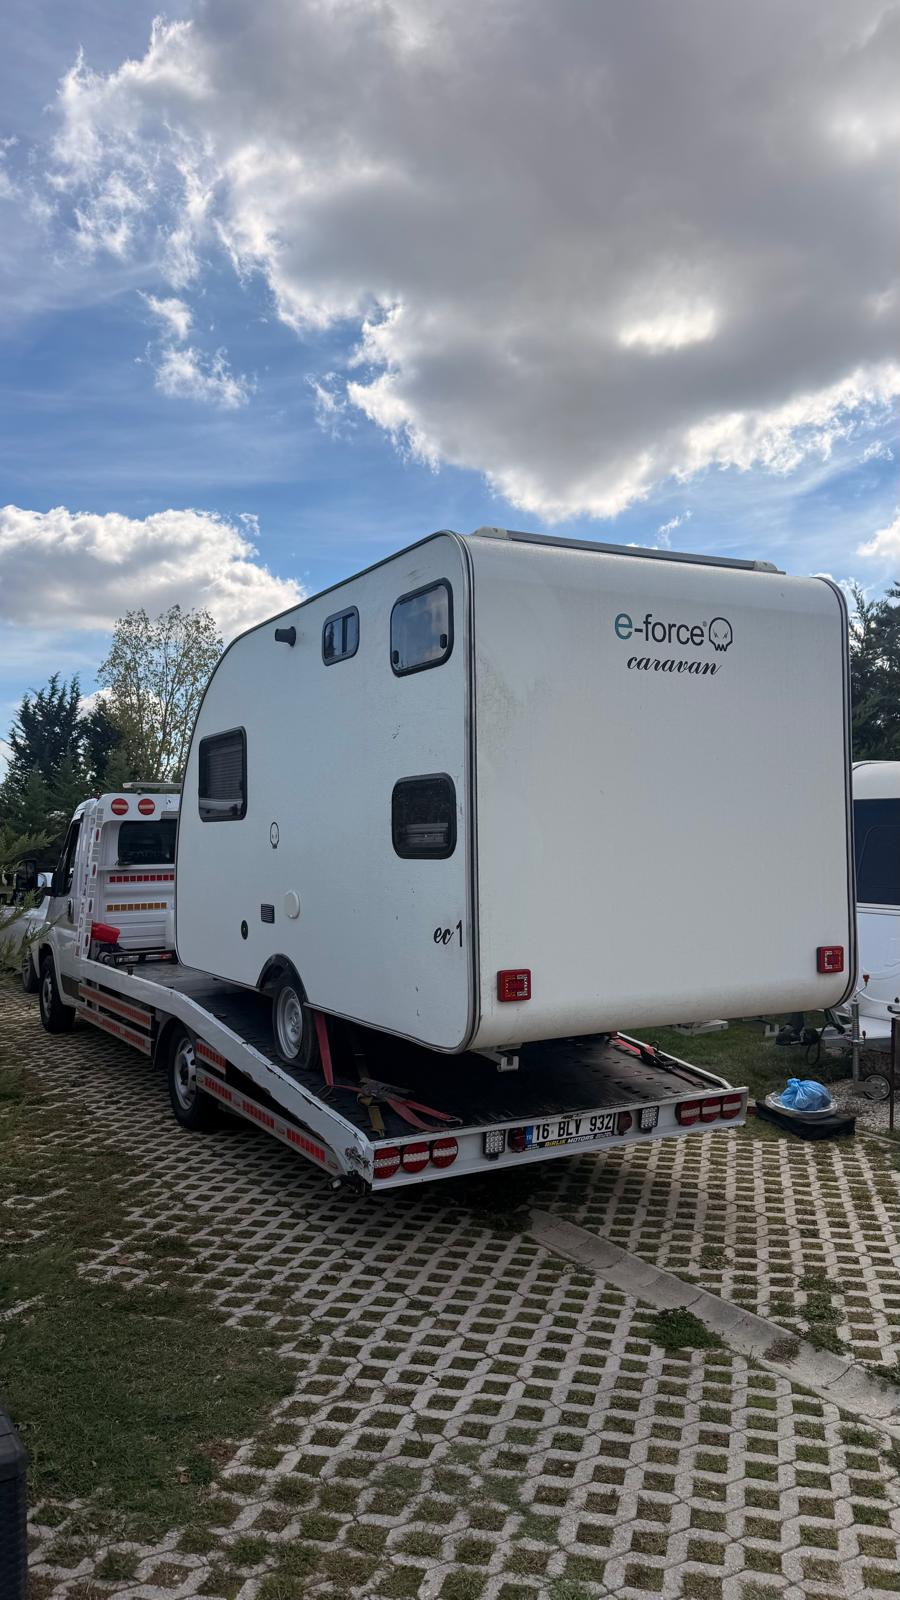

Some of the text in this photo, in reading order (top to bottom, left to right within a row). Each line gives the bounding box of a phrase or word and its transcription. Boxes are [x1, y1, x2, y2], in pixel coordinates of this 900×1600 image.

[614, 613, 705, 647] e-force
[627, 656, 722, 675] caravan
[535, 1124, 550, 1141] 16
[558, 1119, 582, 1137] BLV
[589, 1114, 612, 1132] 932
[567, 1134, 594, 1144] MOTORS
